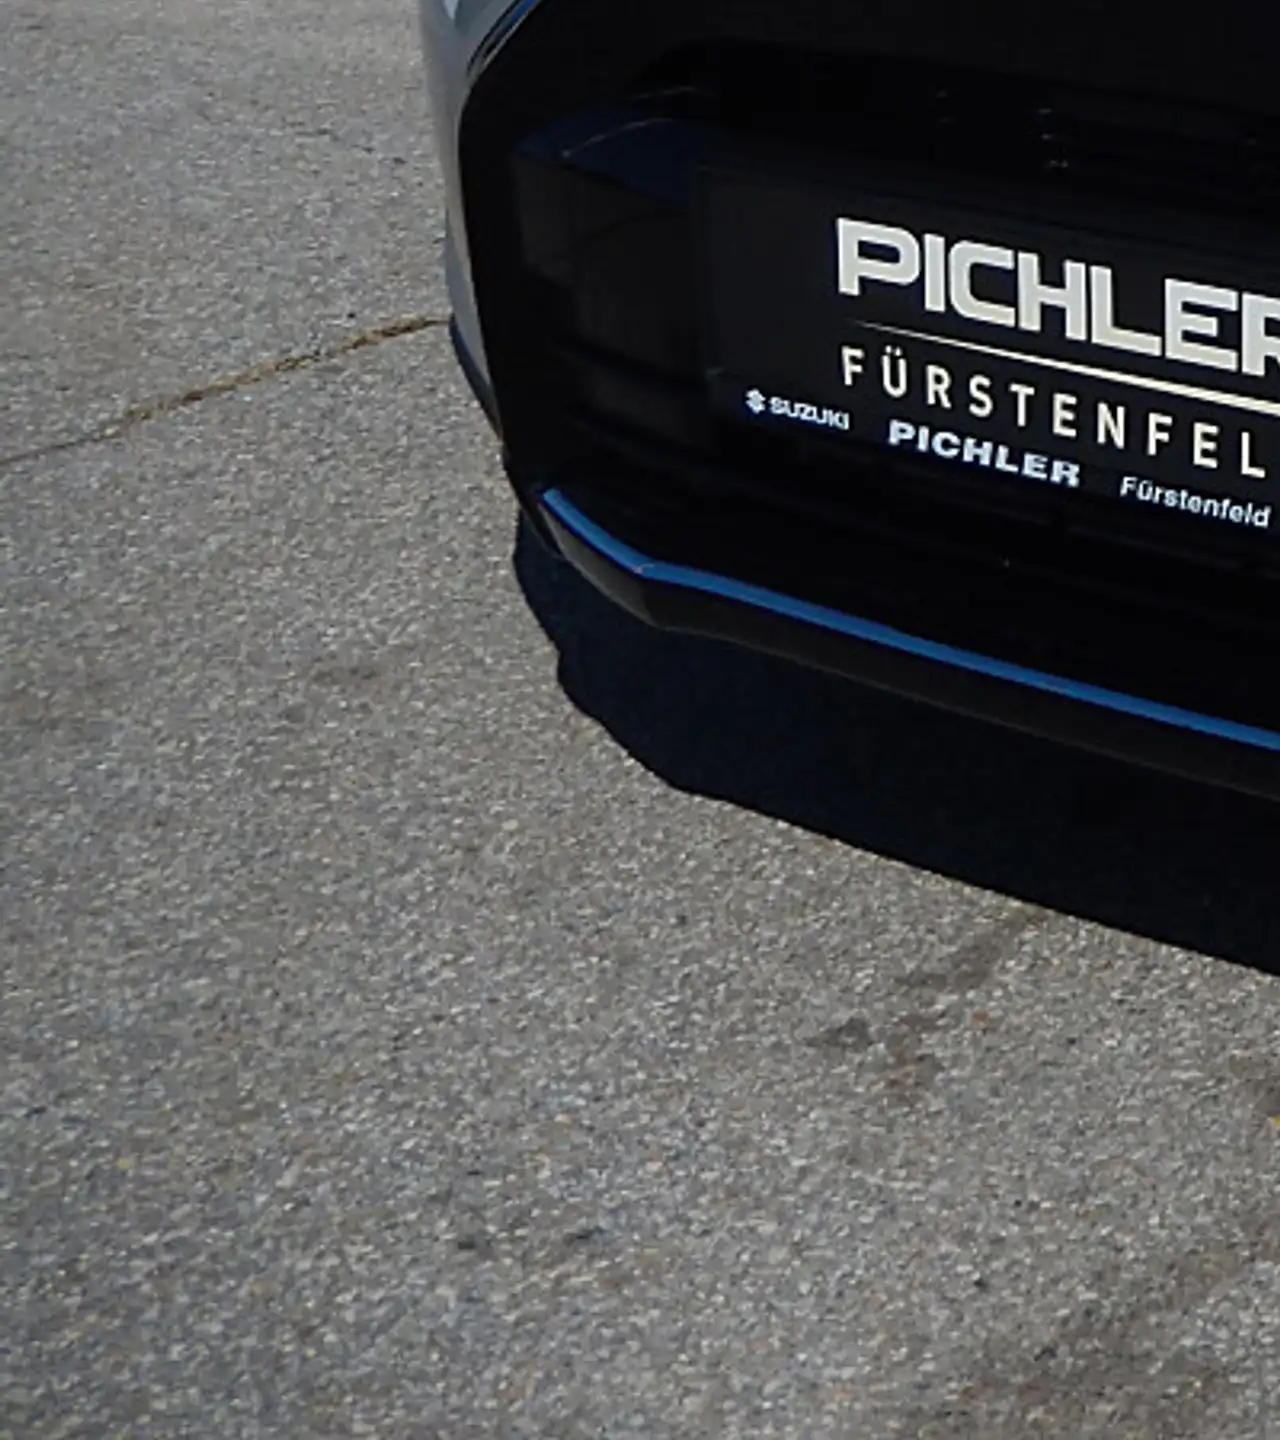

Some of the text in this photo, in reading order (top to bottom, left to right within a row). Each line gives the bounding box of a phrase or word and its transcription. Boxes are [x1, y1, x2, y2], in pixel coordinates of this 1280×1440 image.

[769, 396, 850, 431] SUZUKI
[887, 419, 1080, 488] PICHLER
[1119, 476, 1272, 528] Fürstenfeld
